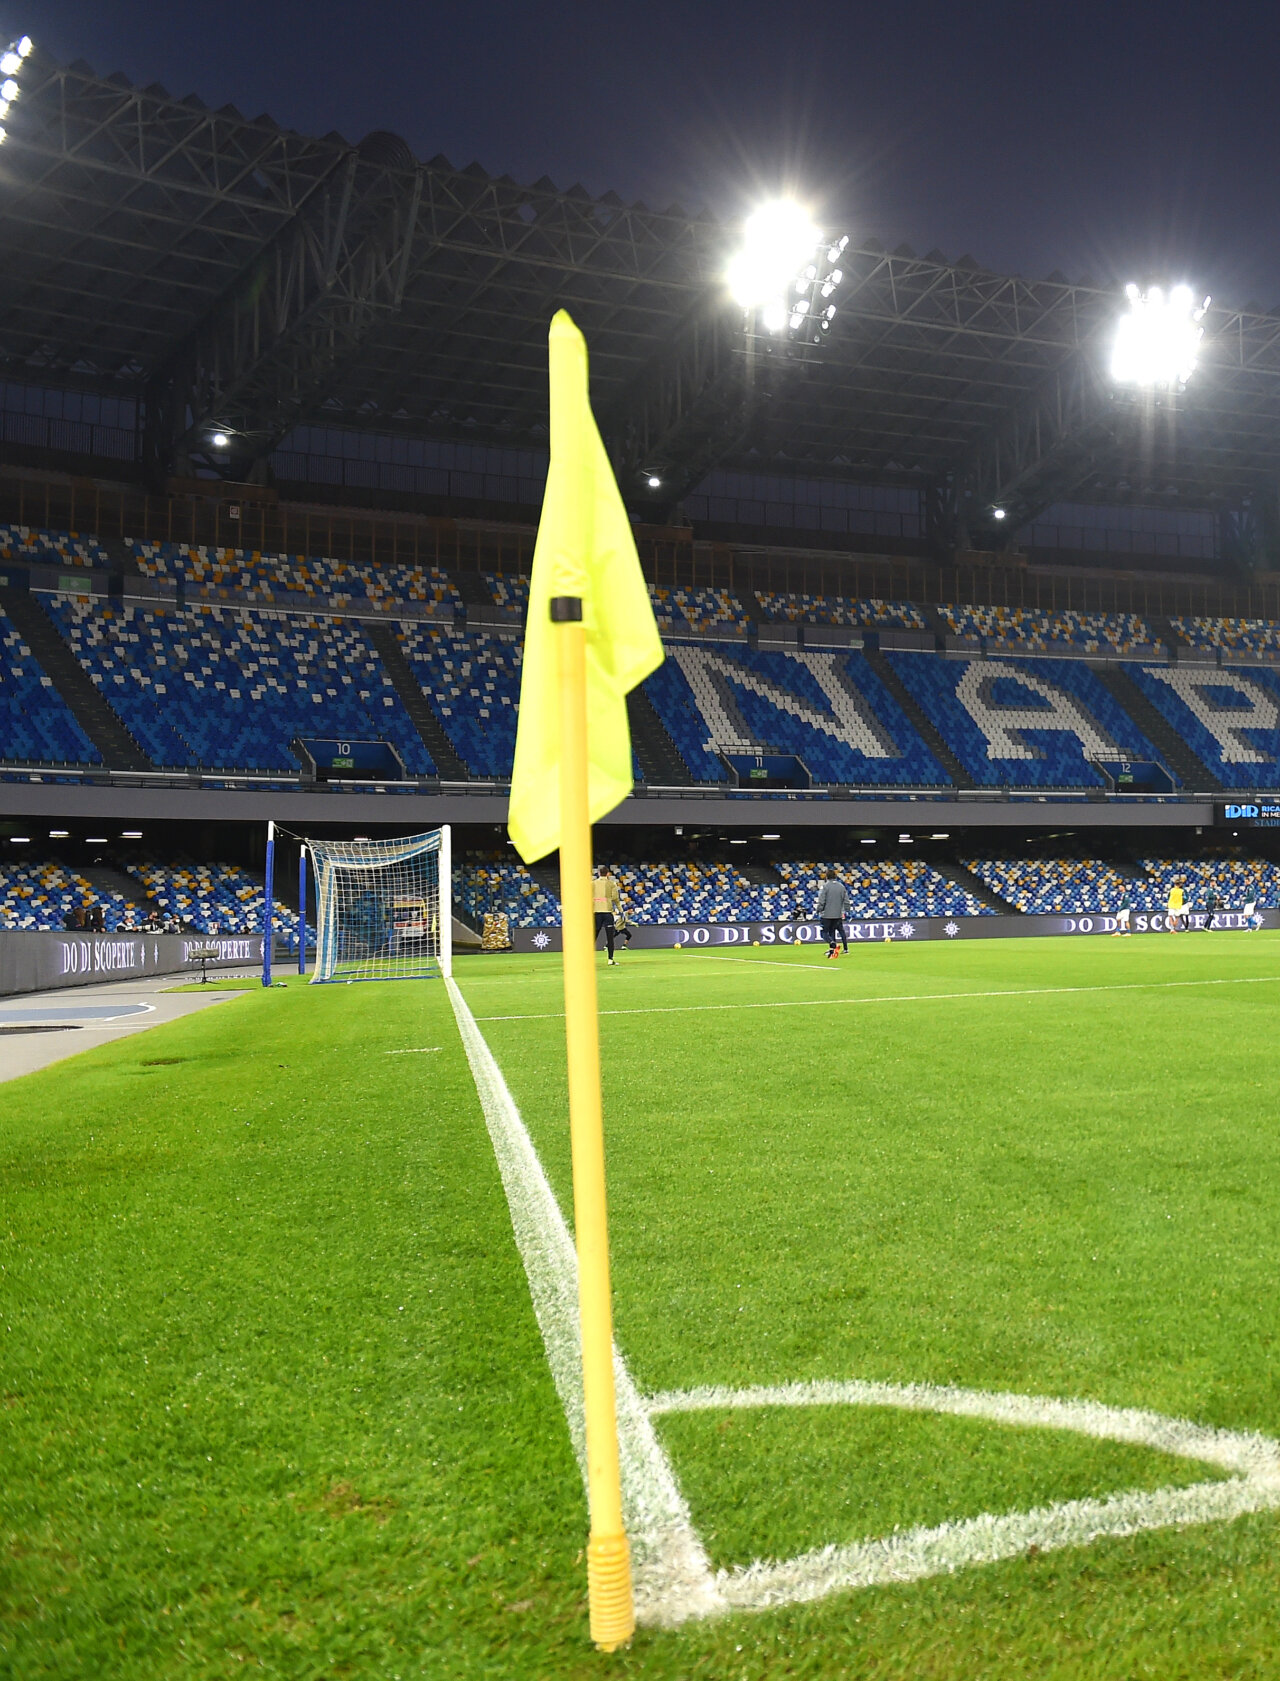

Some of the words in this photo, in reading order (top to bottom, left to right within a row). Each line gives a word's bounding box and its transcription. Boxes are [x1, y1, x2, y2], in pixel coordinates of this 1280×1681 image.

[336, 743, 350, 755] 10
[755, 756, 763, 768] 11
[1121, 763, 1131, 773] 12
[724, 927, 750, 943] DI
[63, 942, 78, 973] DO
[81, 942, 91, 972] DI
[94, 941, 135, 971] SCOPERTE
